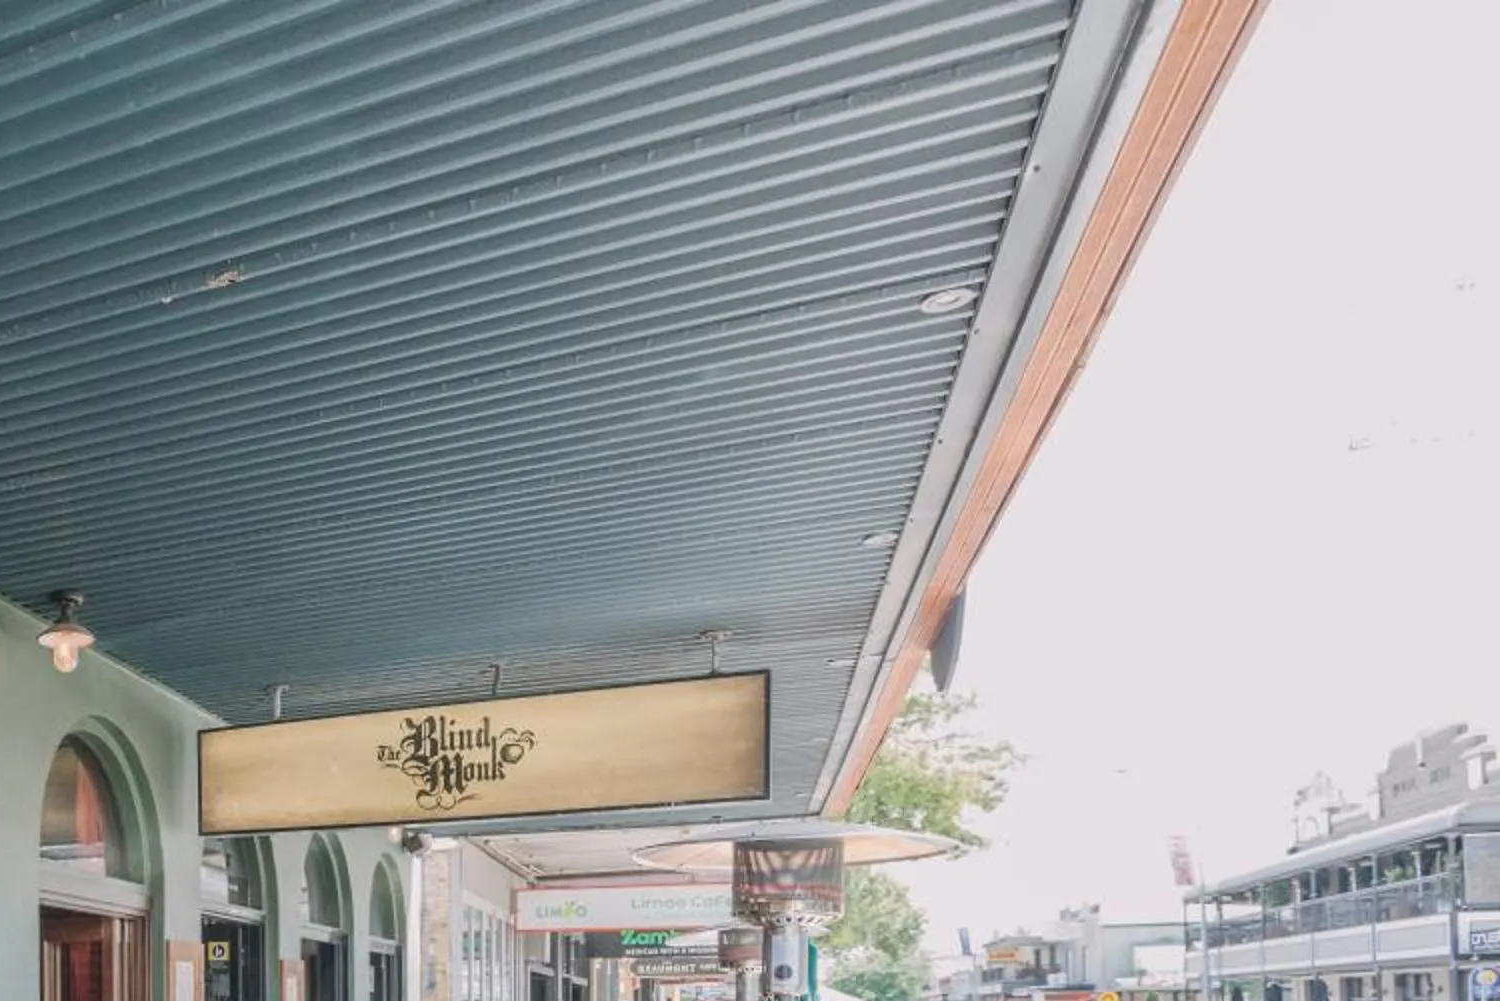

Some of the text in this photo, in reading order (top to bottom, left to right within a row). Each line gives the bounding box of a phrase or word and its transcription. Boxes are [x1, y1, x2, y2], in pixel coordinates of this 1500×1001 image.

[376, 744, 402, 765] The
[400, 714, 492, 774] Blind
[422, 735, 507, 797] Monk
